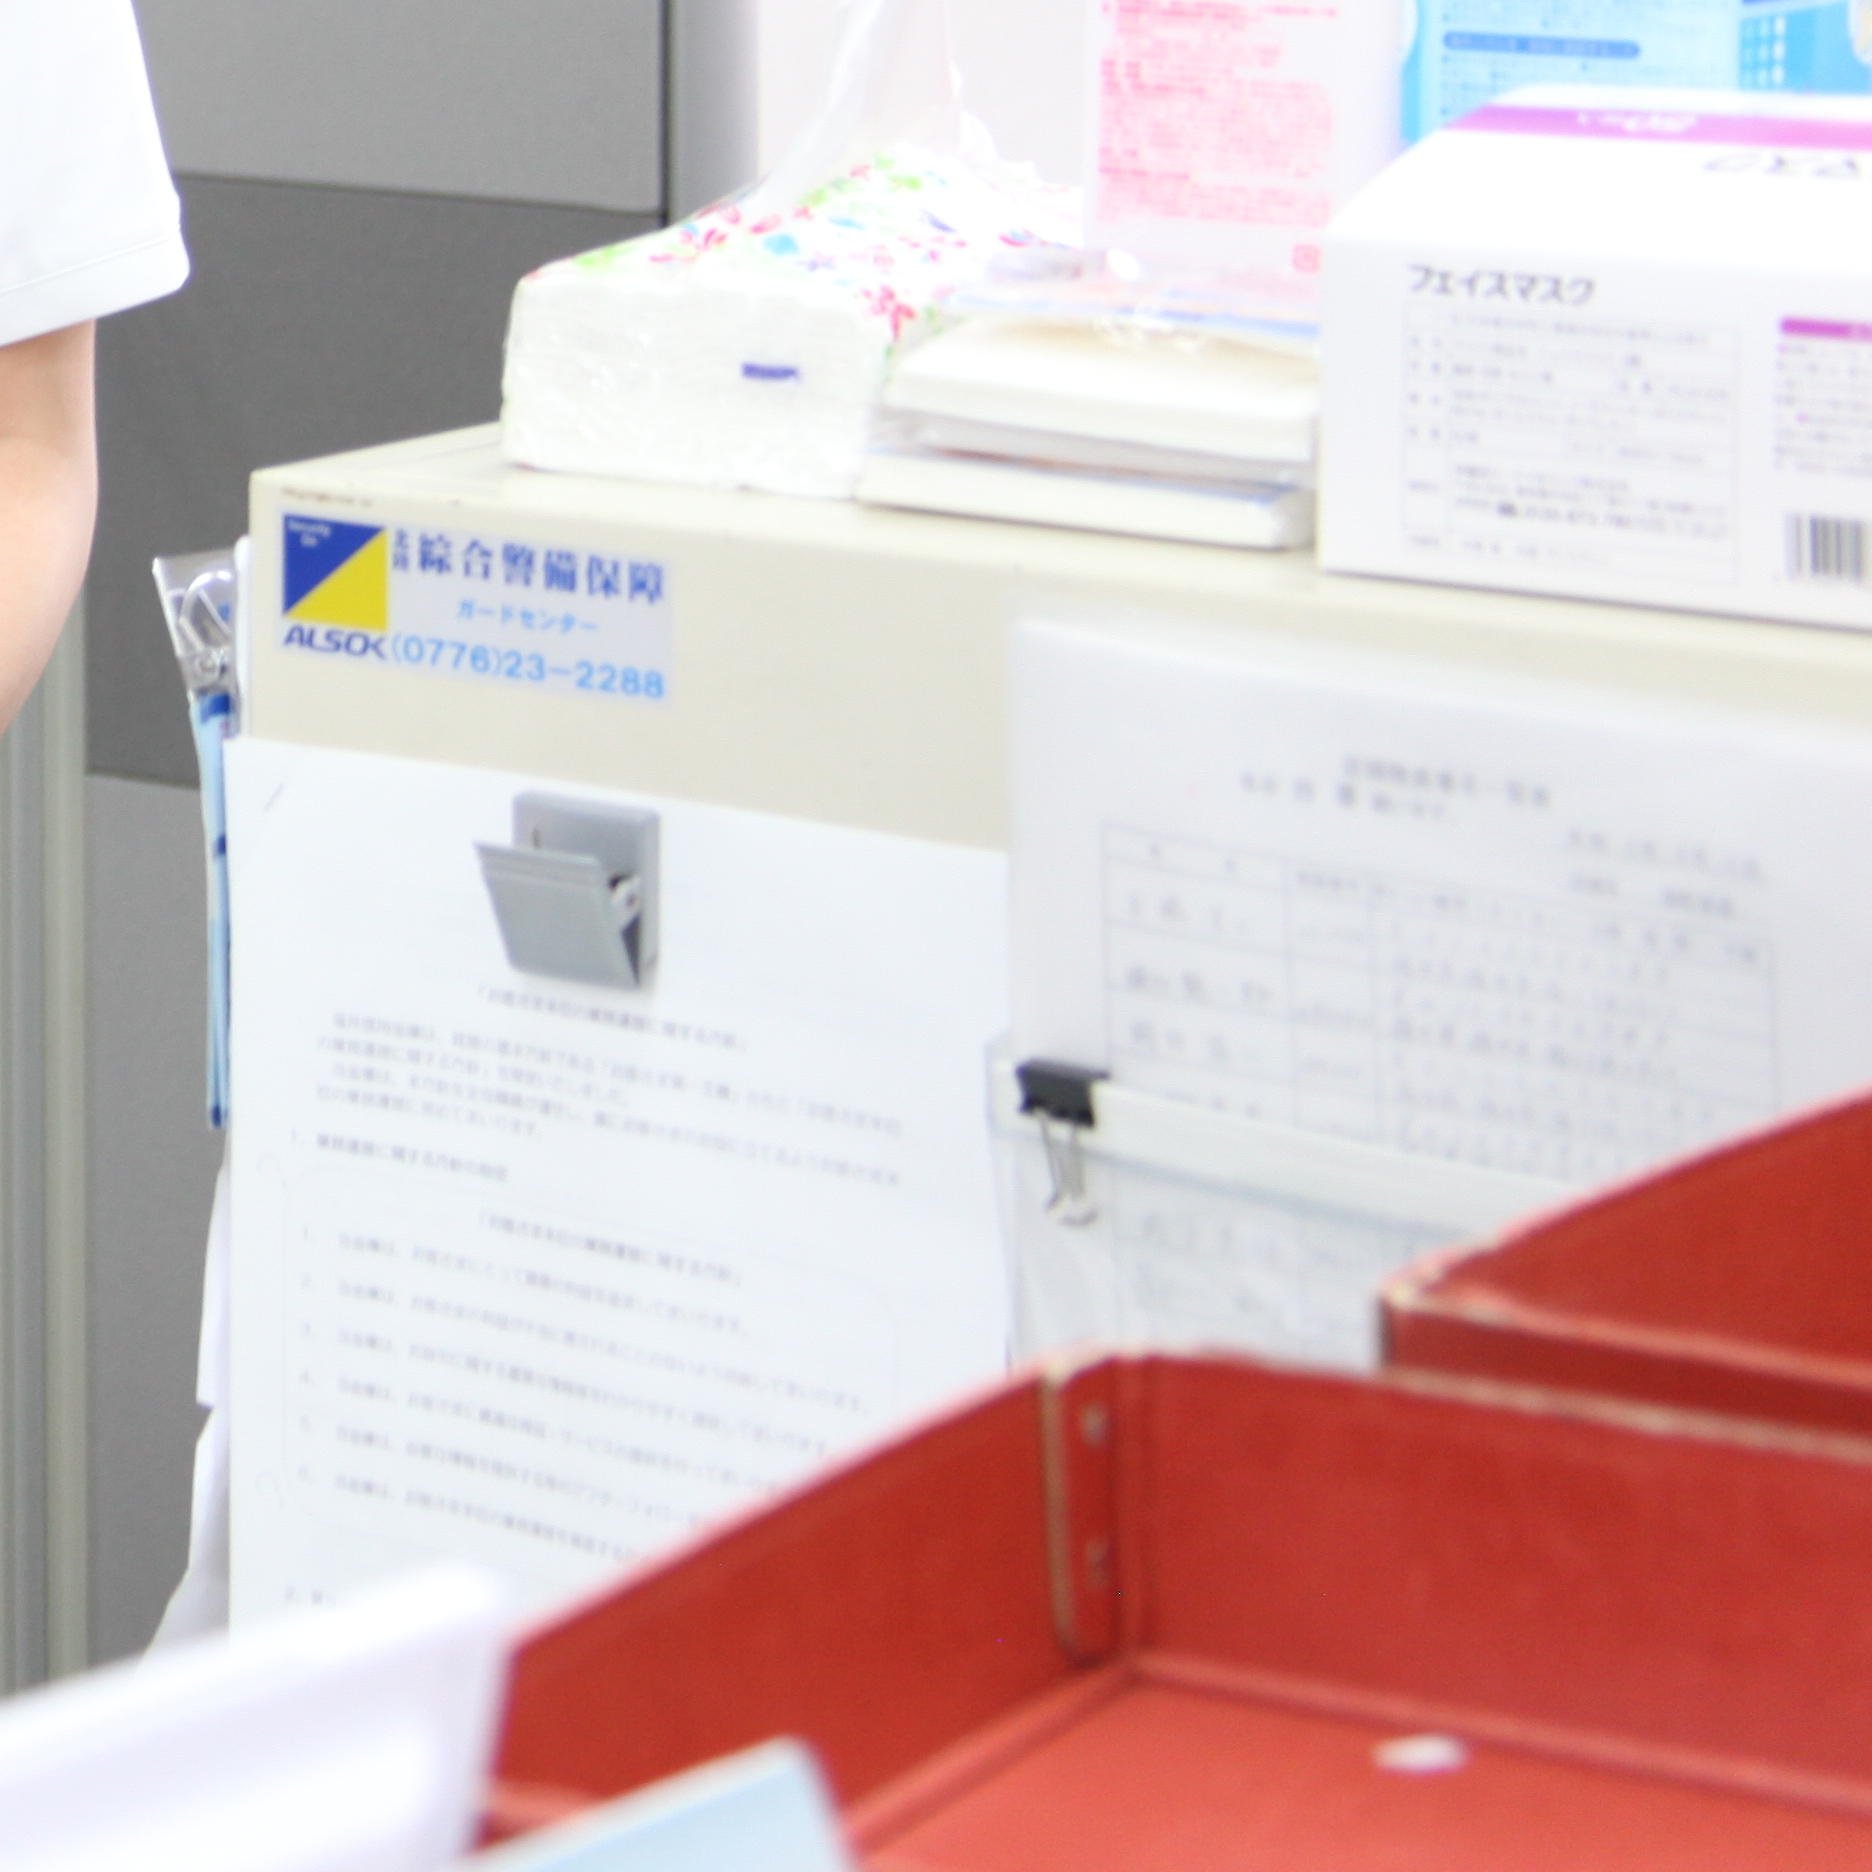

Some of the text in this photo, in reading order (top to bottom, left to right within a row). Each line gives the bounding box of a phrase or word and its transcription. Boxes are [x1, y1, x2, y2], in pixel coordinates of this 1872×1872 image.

[1409, 264, 1595, 306] フェイスマスク
[457, 599, 599, 633] ガードセンター
[283, 624, 387, 660] ALSOK
